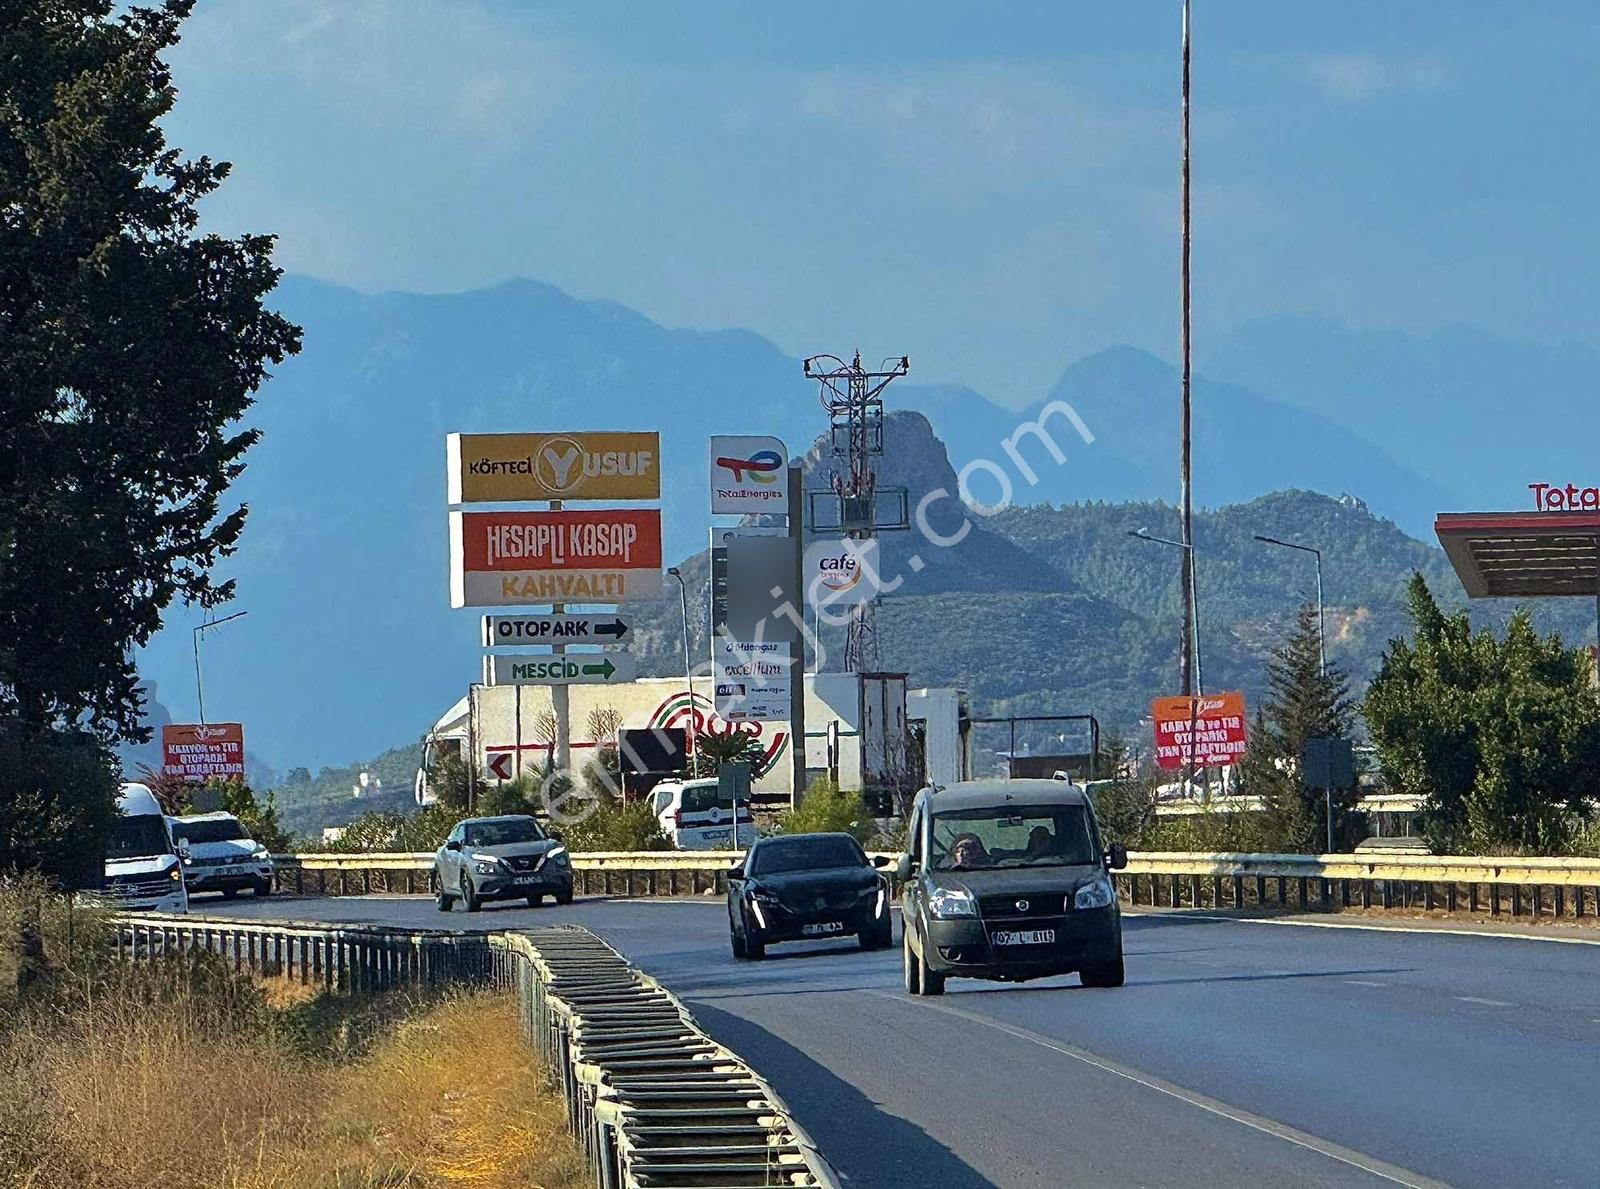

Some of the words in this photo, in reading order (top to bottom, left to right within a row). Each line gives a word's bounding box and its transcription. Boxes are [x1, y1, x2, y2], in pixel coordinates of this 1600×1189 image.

[543, 447, 653, 488] YUSUF
[716, 489, 783, 500] TotalEnergies
[1528, 483, 1600, 508] Tota
[487, 524, 565, 566] HESAPLI
[570, 523, 637, 563] KASAP
[820, 553, 856, 570] café
[502, 574, 625, 598] KAHVALTI
[499, 620, 589, 637] OTOPARK
[512, 656, 579, 680] MESCİD
[724, 661, 780, 676] excellium
